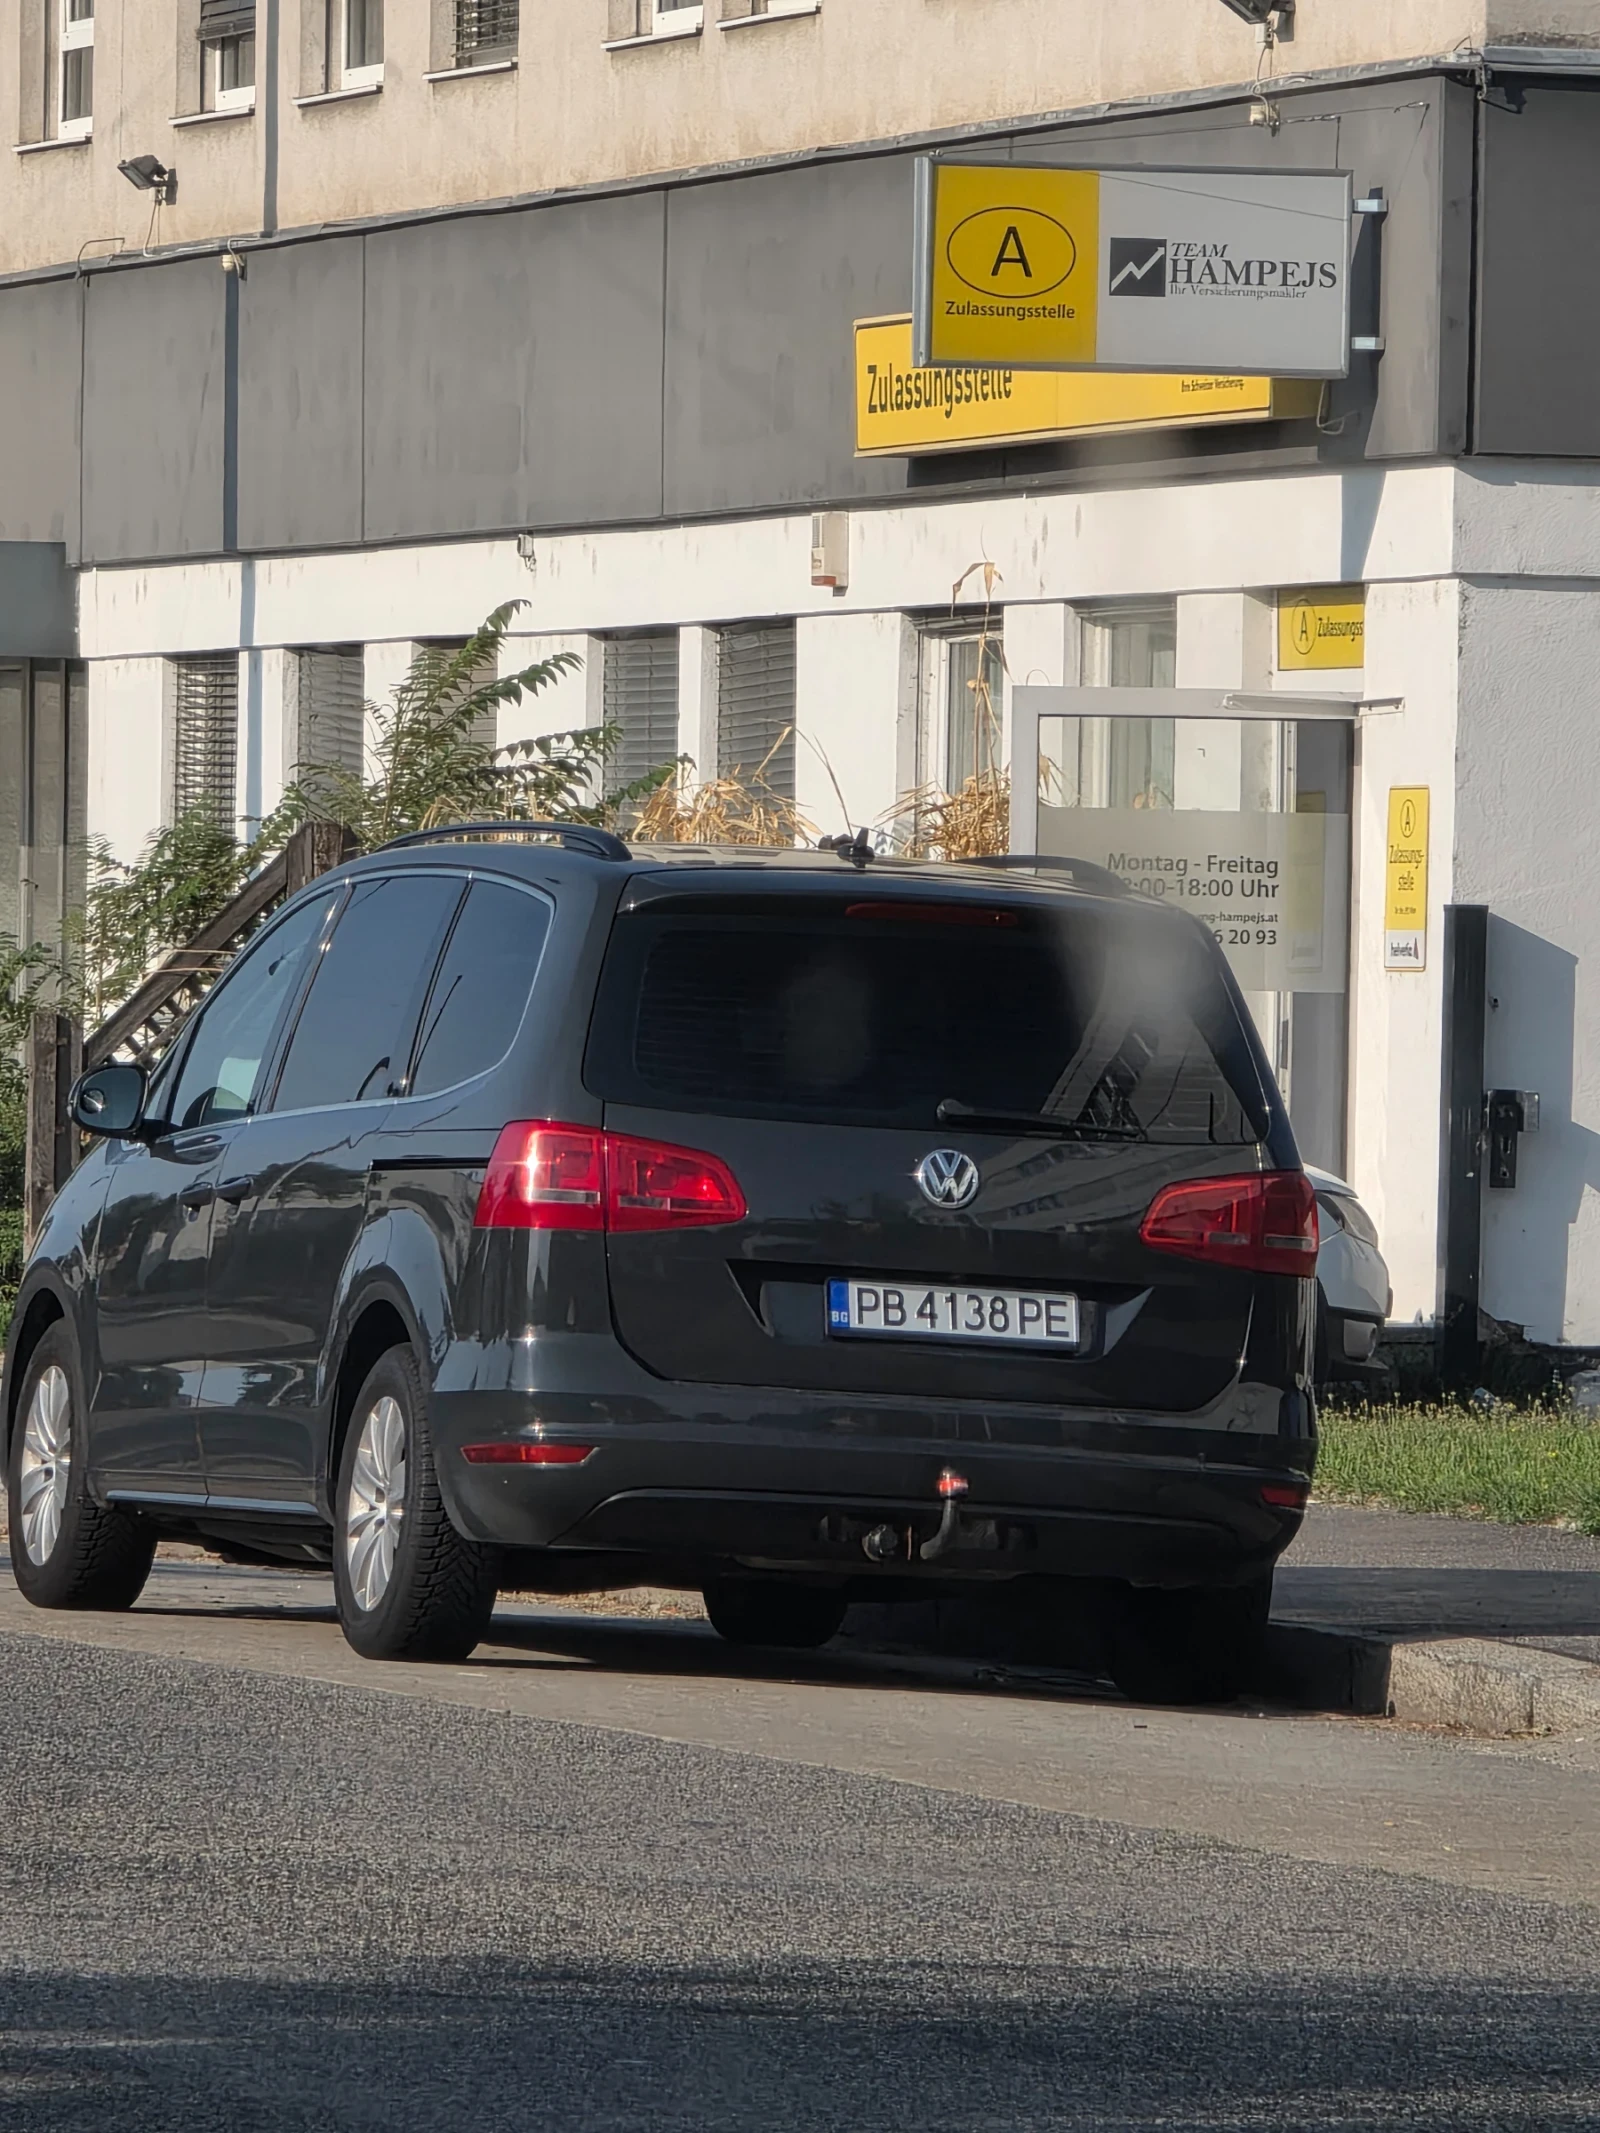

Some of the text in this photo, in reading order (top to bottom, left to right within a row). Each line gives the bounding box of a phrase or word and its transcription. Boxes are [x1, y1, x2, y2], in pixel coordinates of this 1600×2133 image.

[991, 226, 1032, 278] A
[1171, 243, 1228, 258] TEAM
[1168, 258, 1337, 288] HAMPEJS
[1170, 283, 1307, 301] Ihr Versicherungsmakler
[945, 301, 1075, 321] Zulassungsstelle
[867, 363, 1012, 419] Zulassungsstelle
[1299, 610, 1309, 642] A
[1108, 853, 1188, 877] Montag
[1207, 855, 1278, 878] Freitag
[1241, 879, 1279, 898] Uhr
[1228, 929, 1250, 945] 20
[1256, 930, 1277, 945] 93
[831, 1310, 849, 1323] BG
[856, 1287, 1070, 1338] PB 4138 PE
